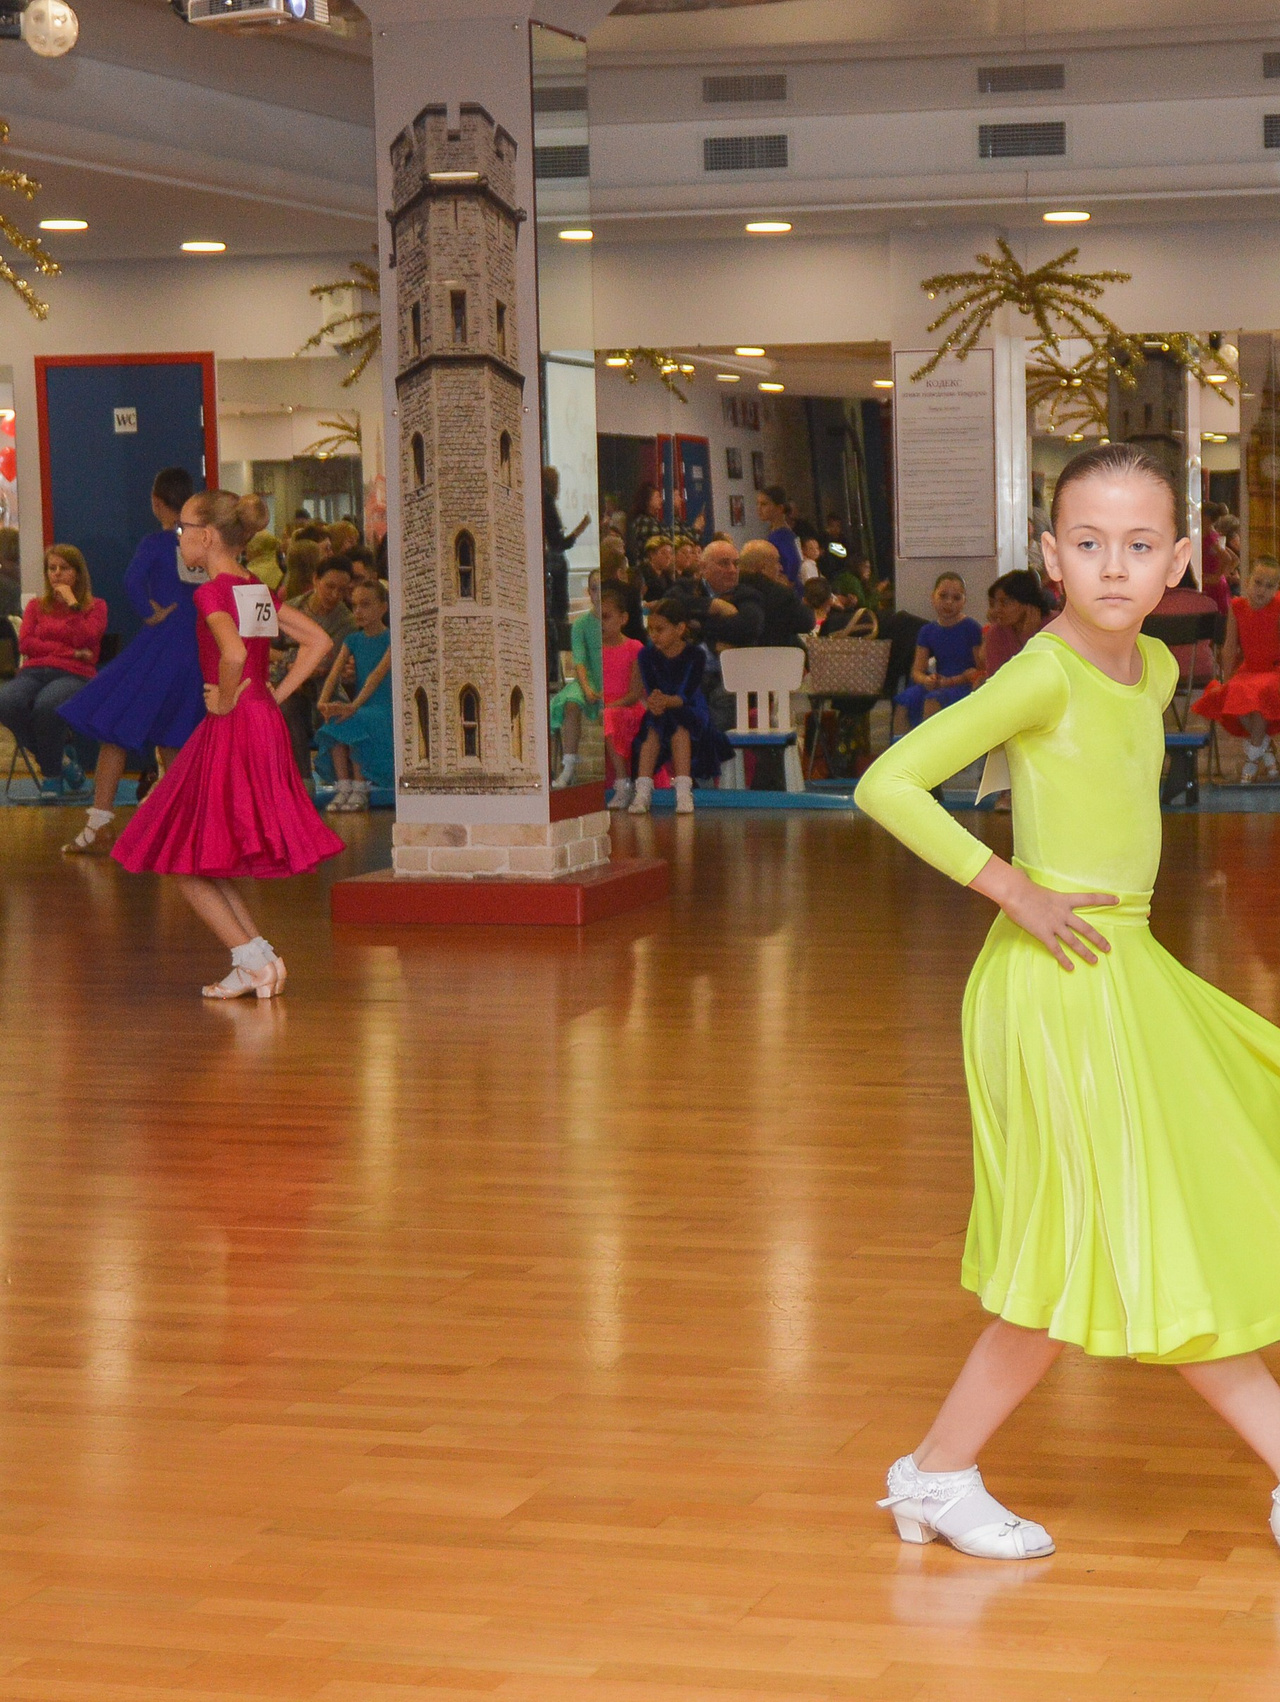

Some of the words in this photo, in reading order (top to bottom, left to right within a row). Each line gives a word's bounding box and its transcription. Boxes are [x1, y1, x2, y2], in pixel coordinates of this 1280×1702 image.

[926, 379, 963, 389] КОДЕКС
[116, 413, 136, 427] WC
[255, 602, 271, 622] 75
